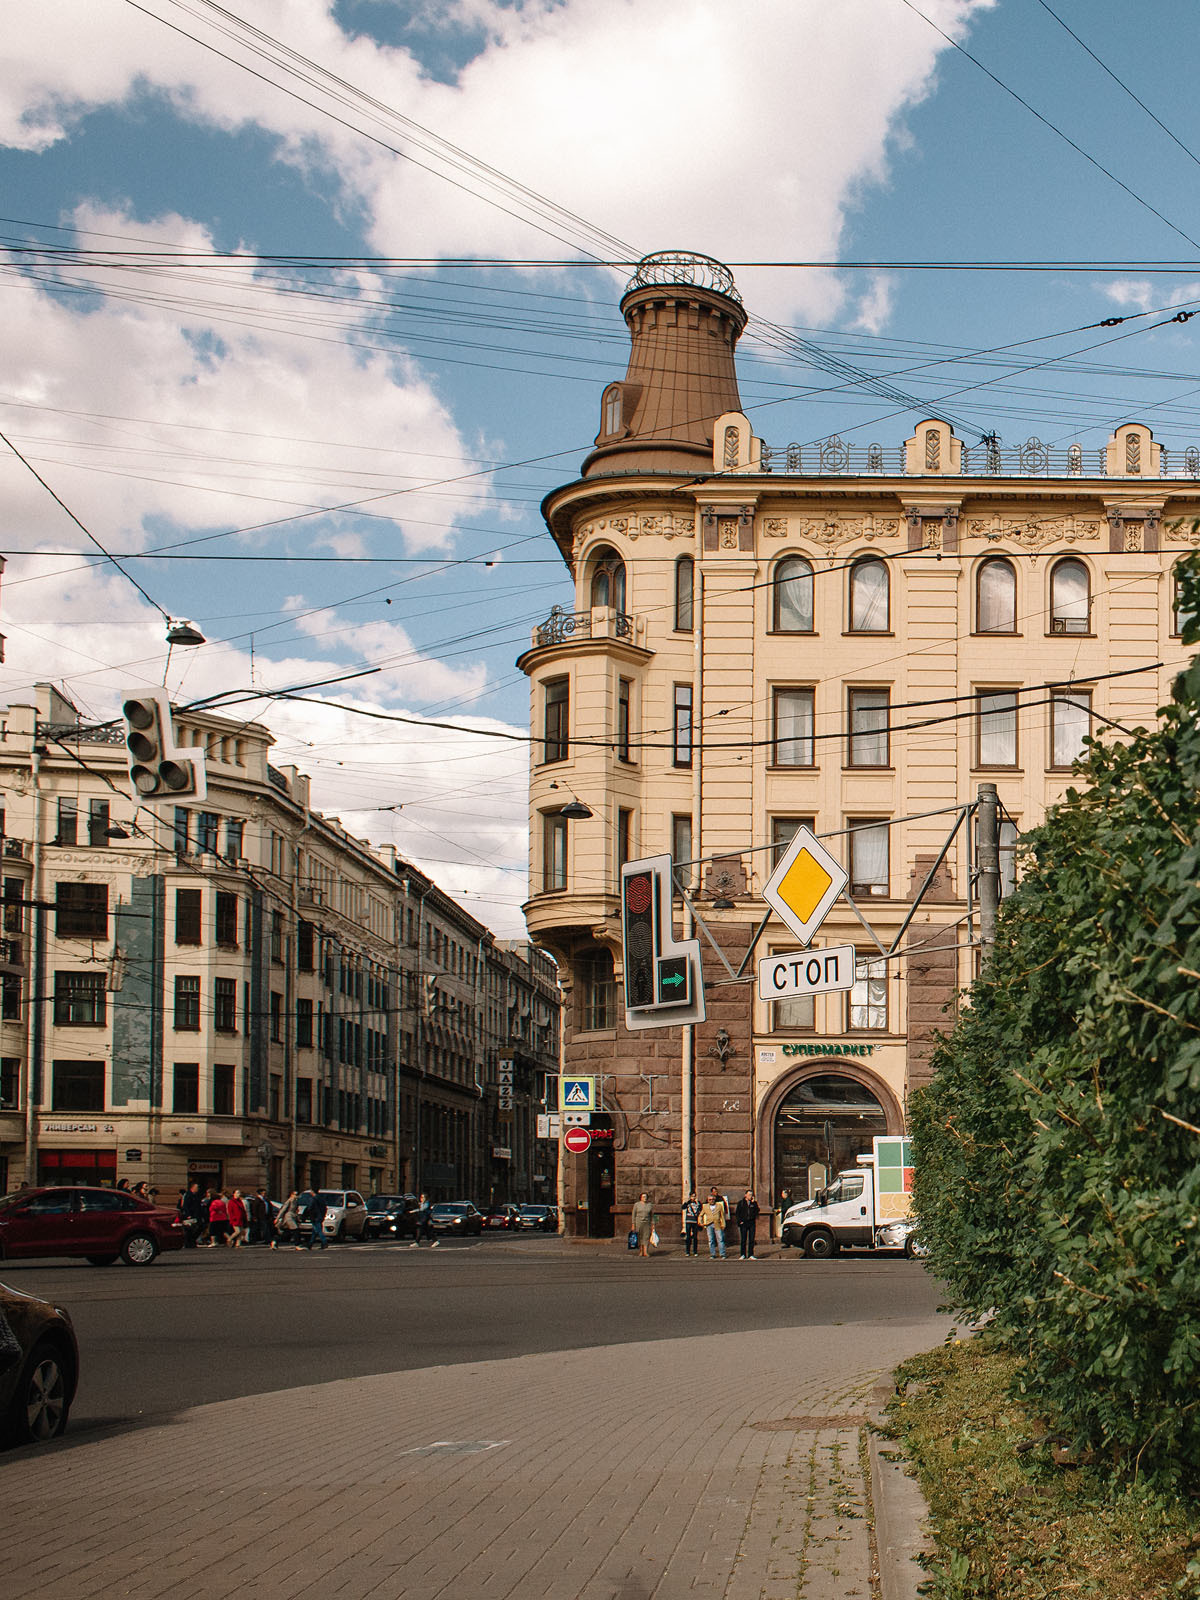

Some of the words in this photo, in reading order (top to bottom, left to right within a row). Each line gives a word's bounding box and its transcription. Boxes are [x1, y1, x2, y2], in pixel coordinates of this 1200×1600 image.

[772, 955, 839, 990] СТОП
[782, 1044, 873, 1056] СУПЕРМАРКЕТ
[501, 1061, 511, 1108] JAZZ
[44, 1124, 97, 1132] УНИВЕРСАМ
